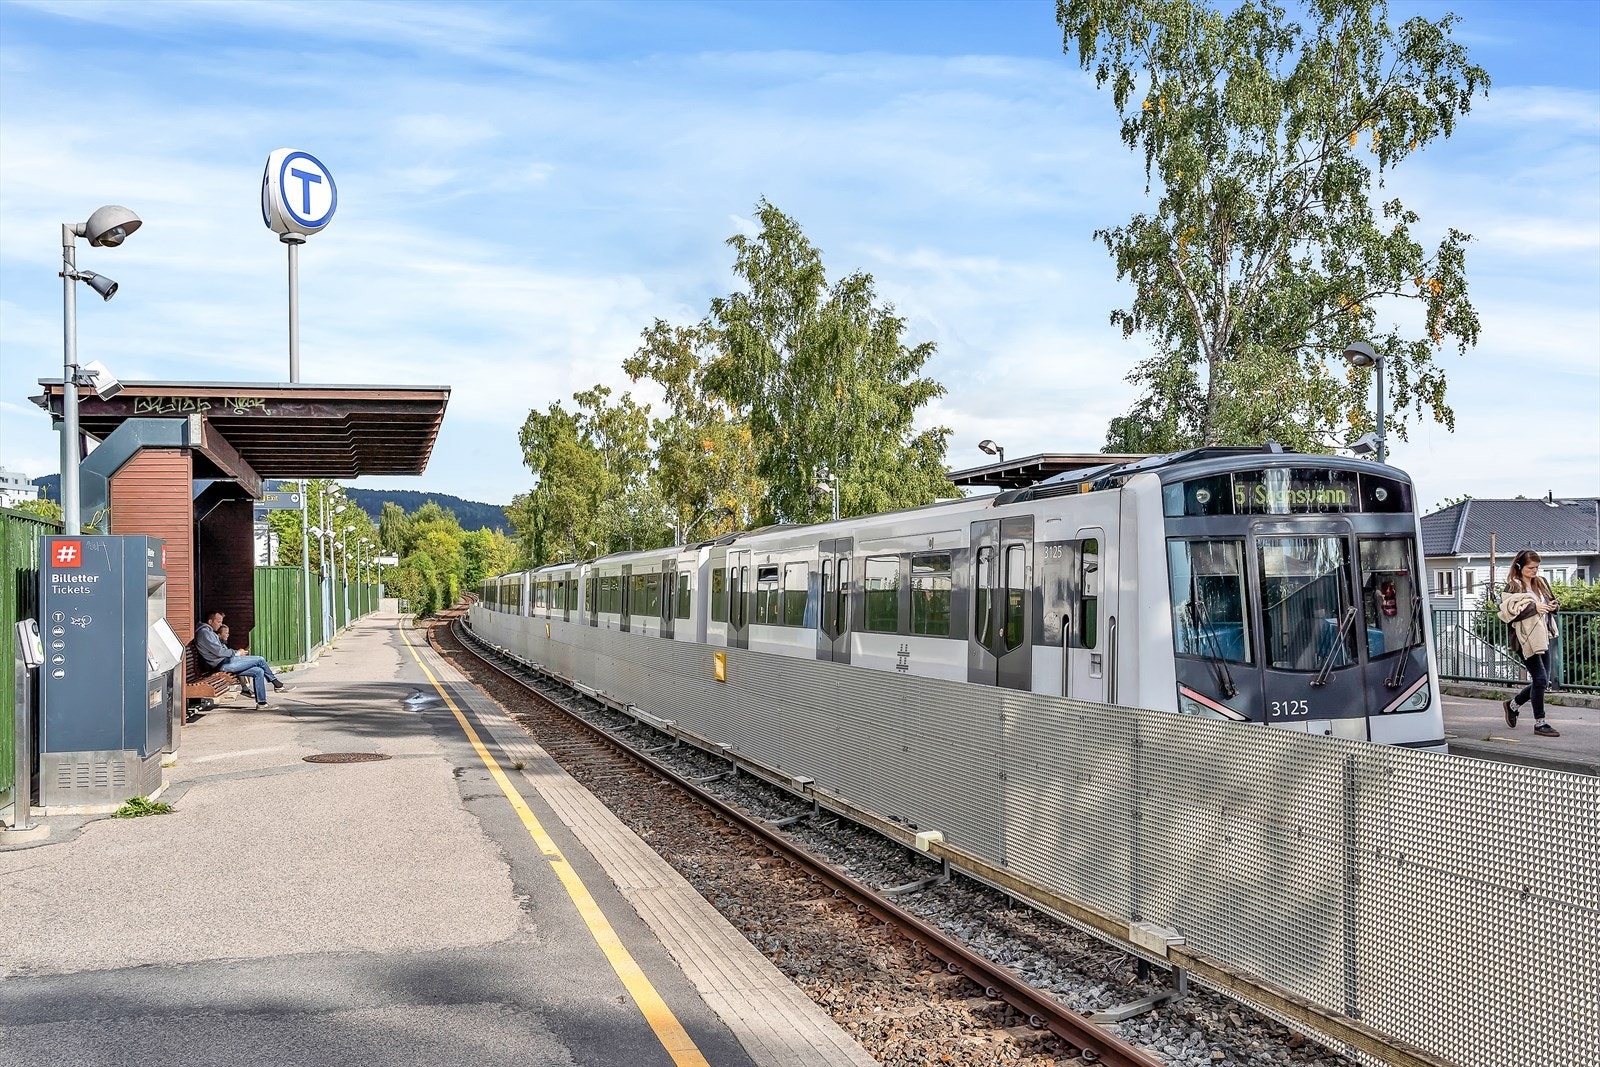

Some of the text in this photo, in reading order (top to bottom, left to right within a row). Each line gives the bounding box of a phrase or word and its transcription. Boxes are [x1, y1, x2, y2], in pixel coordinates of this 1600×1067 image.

[291, 167, 322, 215] T
[1234, 484, 1246, 505] 5
[1044, 545, 1062, 559] 3125
[51, 574, 100, 583] Billetter
[51, 585, 91, 594] Tickets
[1271, 700, 1309, 716] 3125
